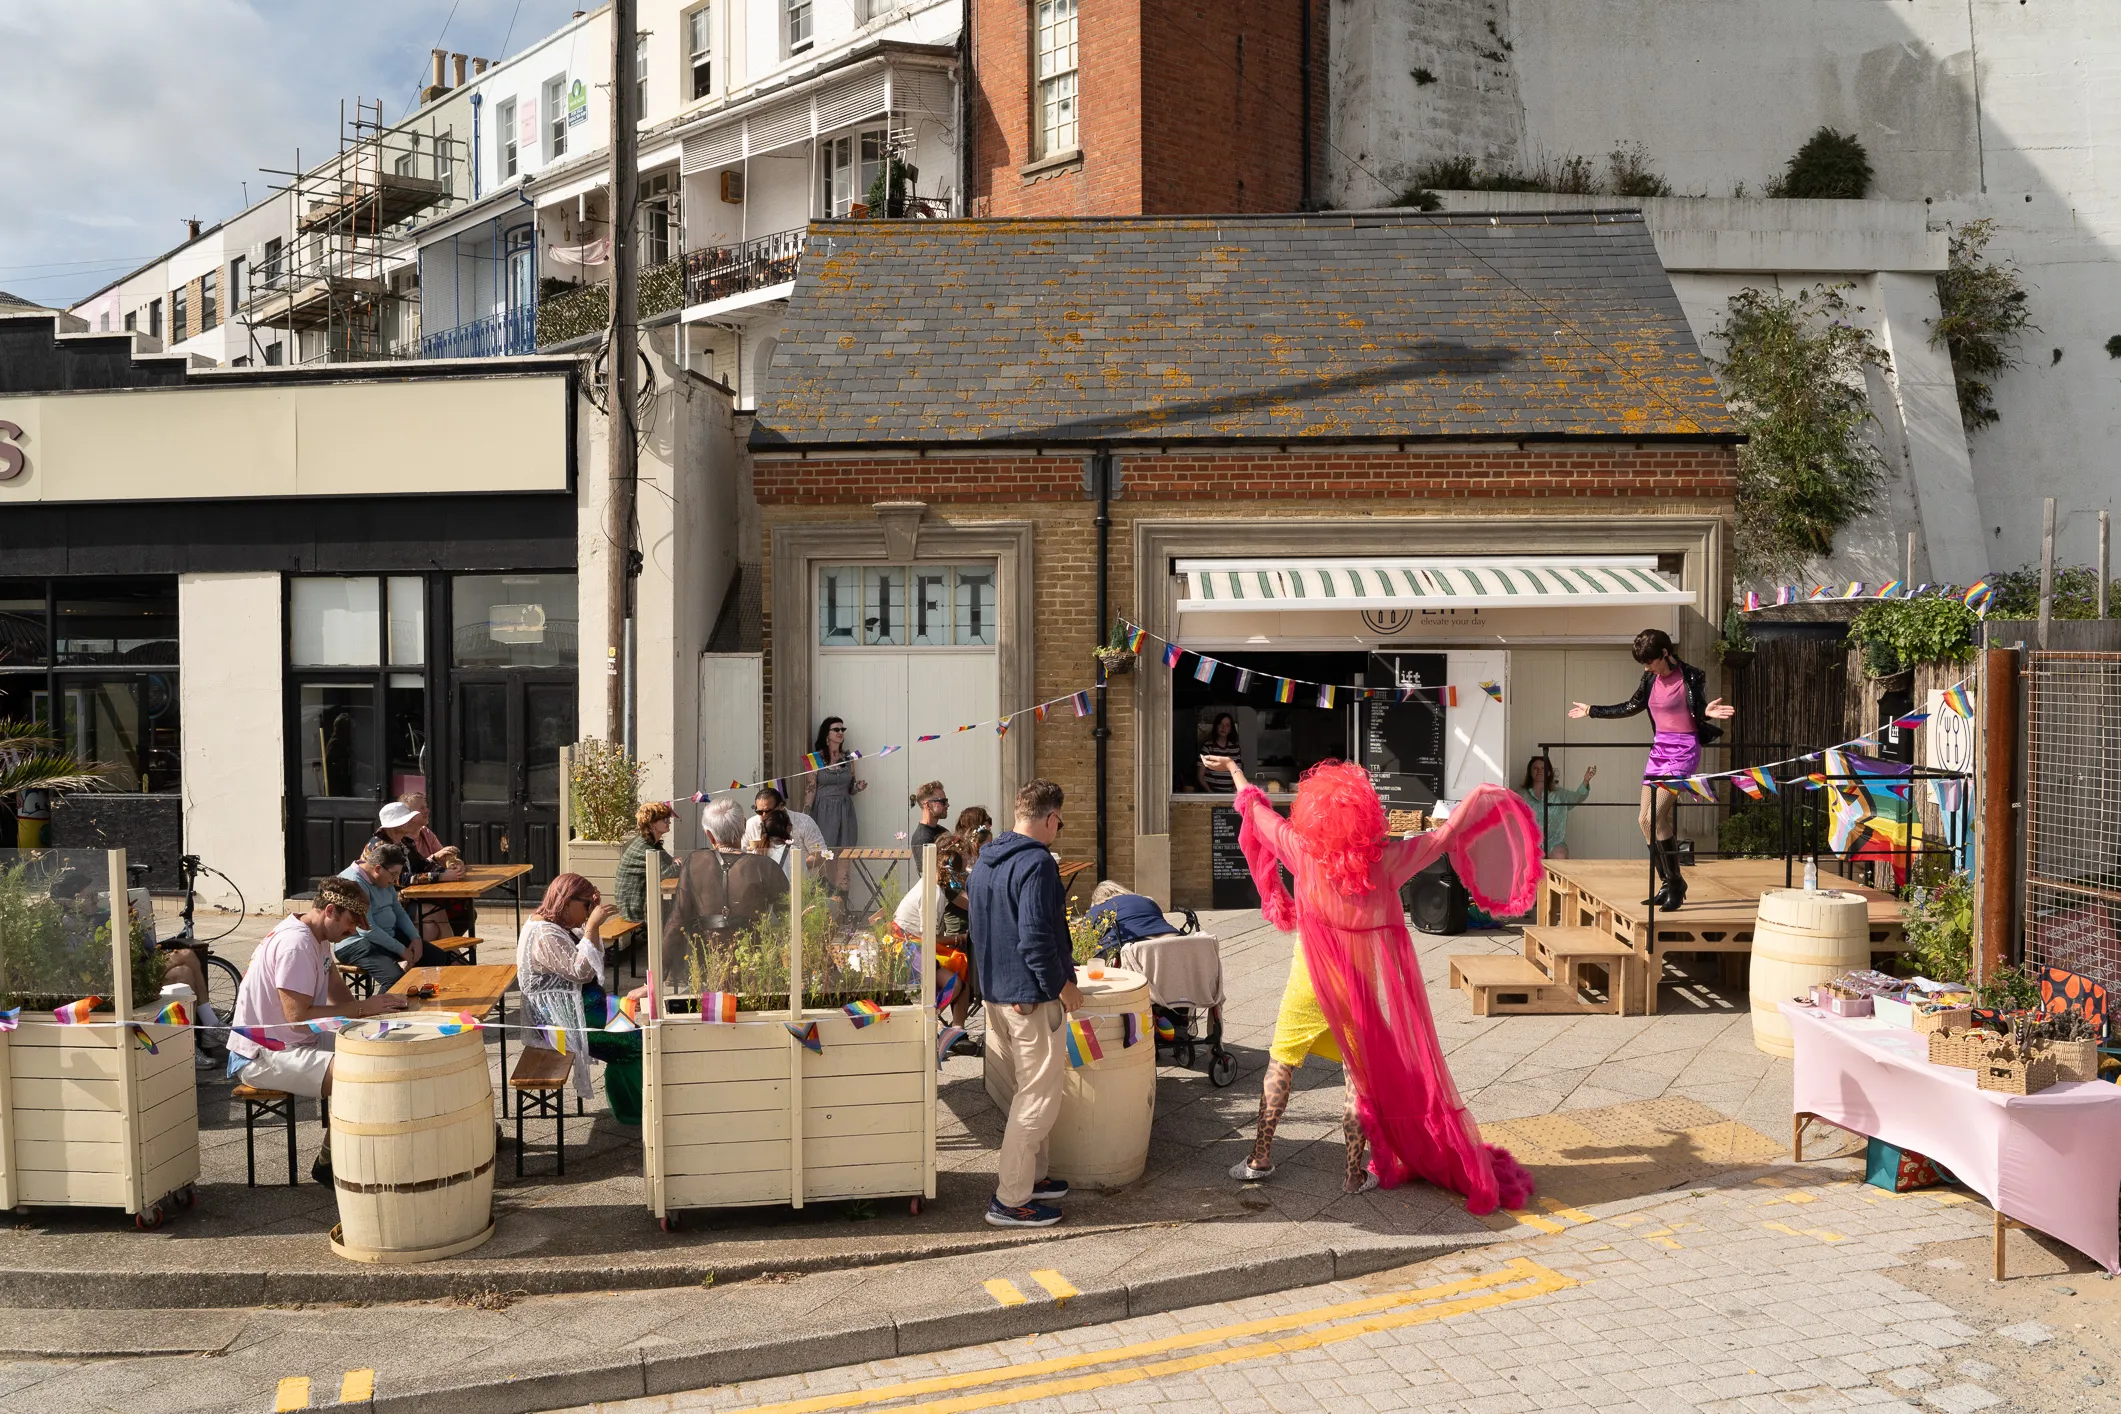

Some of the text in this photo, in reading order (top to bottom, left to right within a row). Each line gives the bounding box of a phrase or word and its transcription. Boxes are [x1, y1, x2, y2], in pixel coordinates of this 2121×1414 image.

[827, 575, 990, 636] LIFT
[1421, 616, 1486, 628] elevate your day
[1395, 656, 1422, 688] Lift
[1370, 764, 1381, 772] TEA
